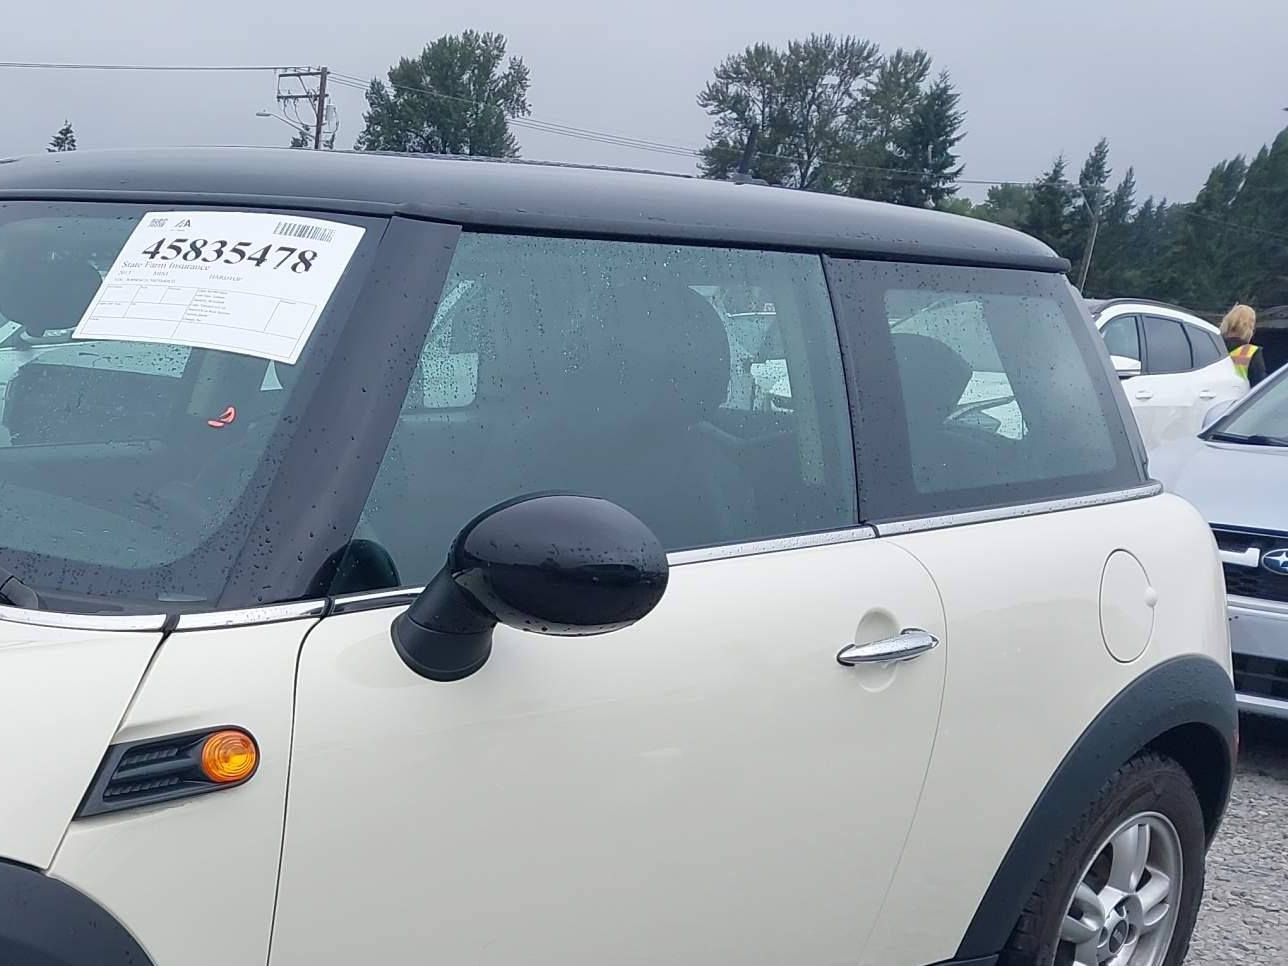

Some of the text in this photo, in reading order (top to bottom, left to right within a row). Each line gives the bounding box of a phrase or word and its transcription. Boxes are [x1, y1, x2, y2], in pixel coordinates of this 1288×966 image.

[121, 260, 211, 271] State Farm Insurance
[141, 237, 318, 274] 45835478
